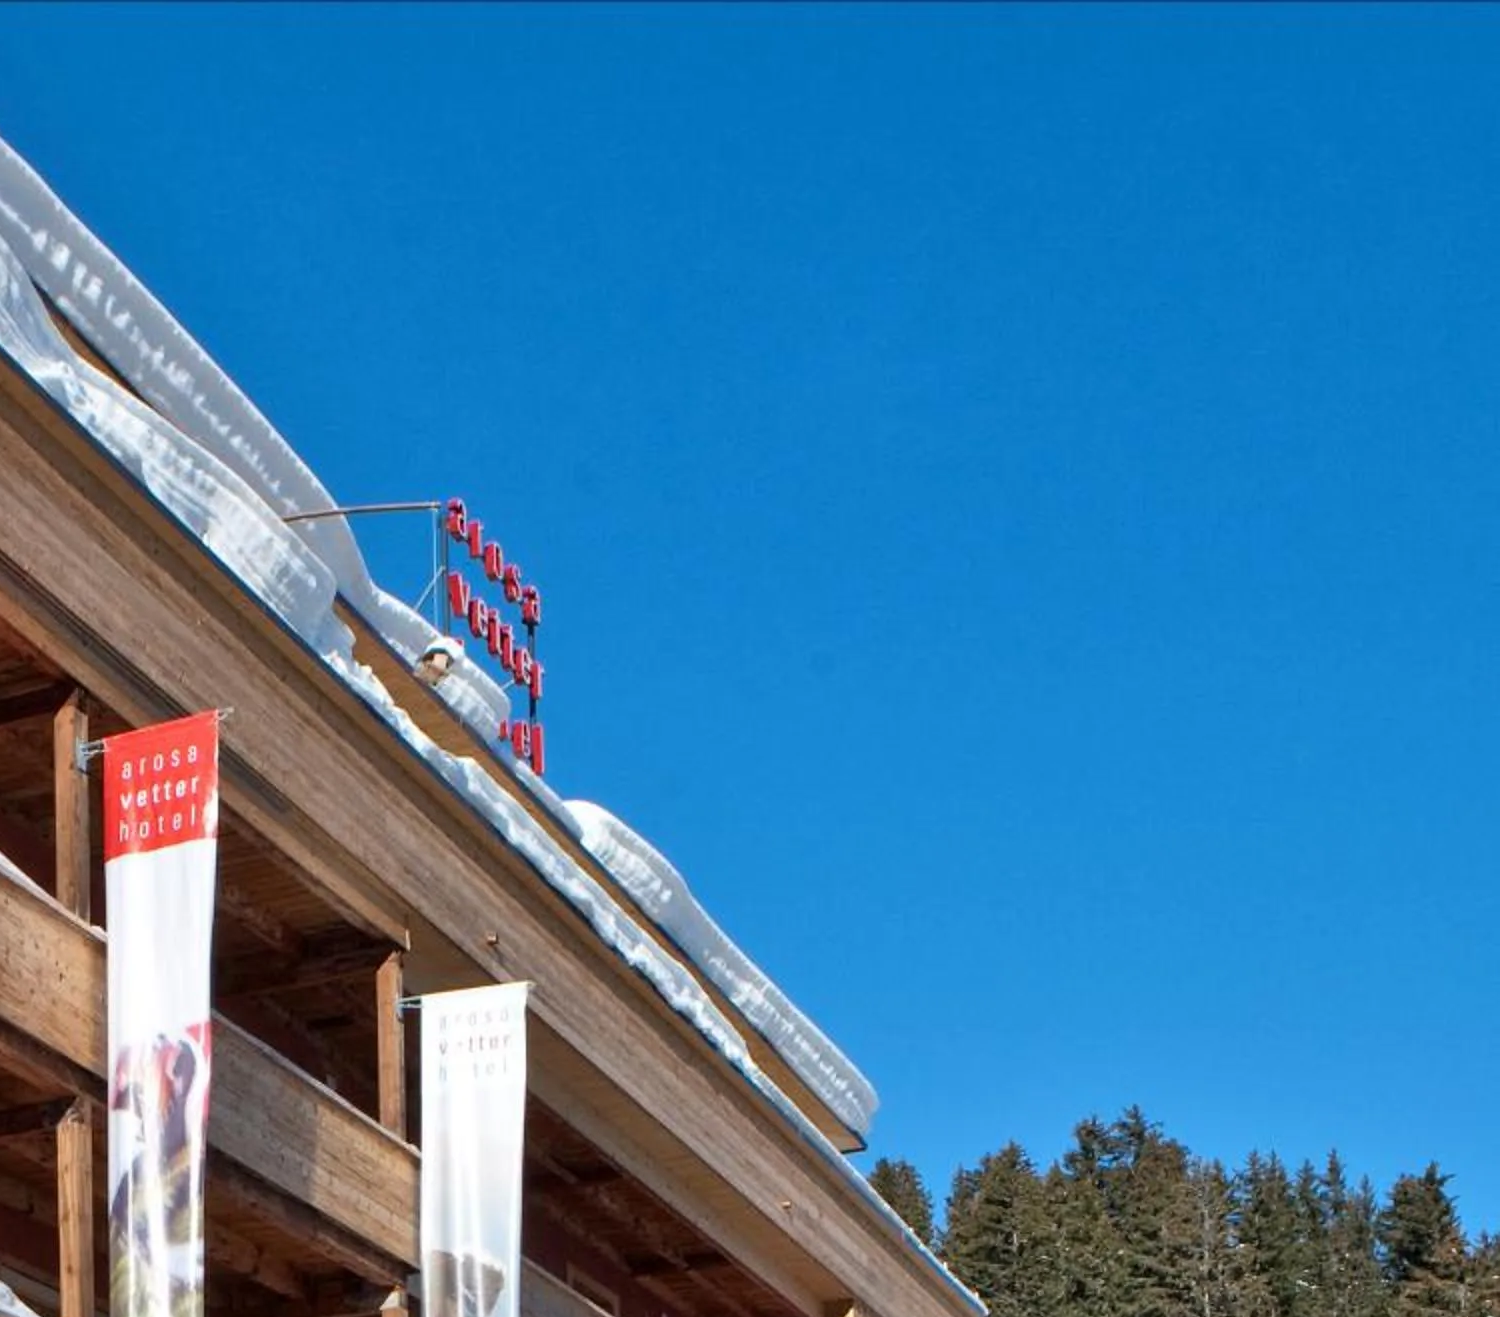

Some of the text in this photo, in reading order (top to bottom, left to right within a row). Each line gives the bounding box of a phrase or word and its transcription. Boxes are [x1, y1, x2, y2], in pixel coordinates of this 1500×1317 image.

[121, 745, 198, 780] arosa
[120, 775, 199, 810] vetter
[119, 803, 196, 842] hotel
[439, 1054, 508, 1082] htel
